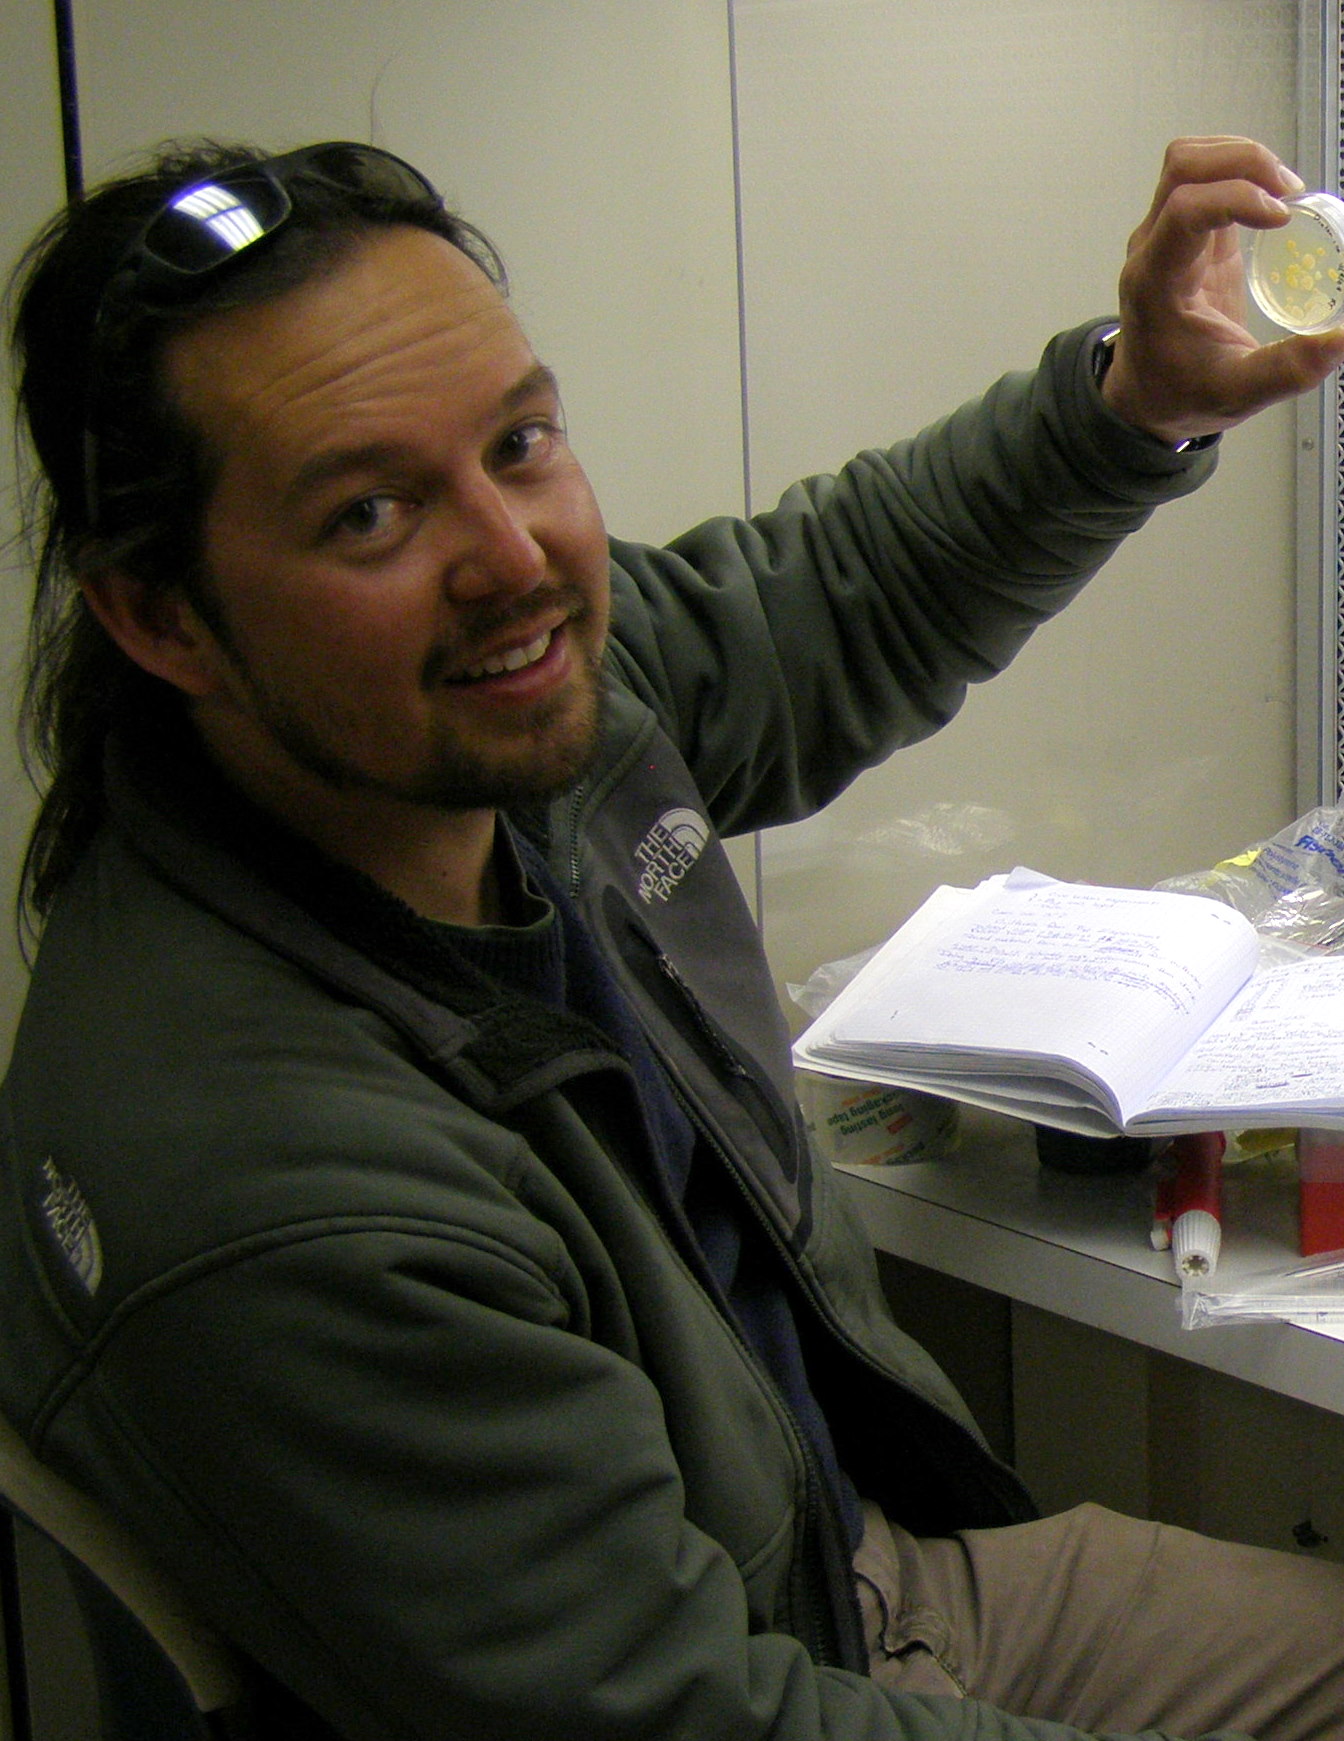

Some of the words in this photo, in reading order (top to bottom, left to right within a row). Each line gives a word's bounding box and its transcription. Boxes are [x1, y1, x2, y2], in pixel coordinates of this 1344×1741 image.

[633, 821, 671, 863] THE
[638, 837, 684, 904] NORTH
[653, 848, 695, 902] FACE
